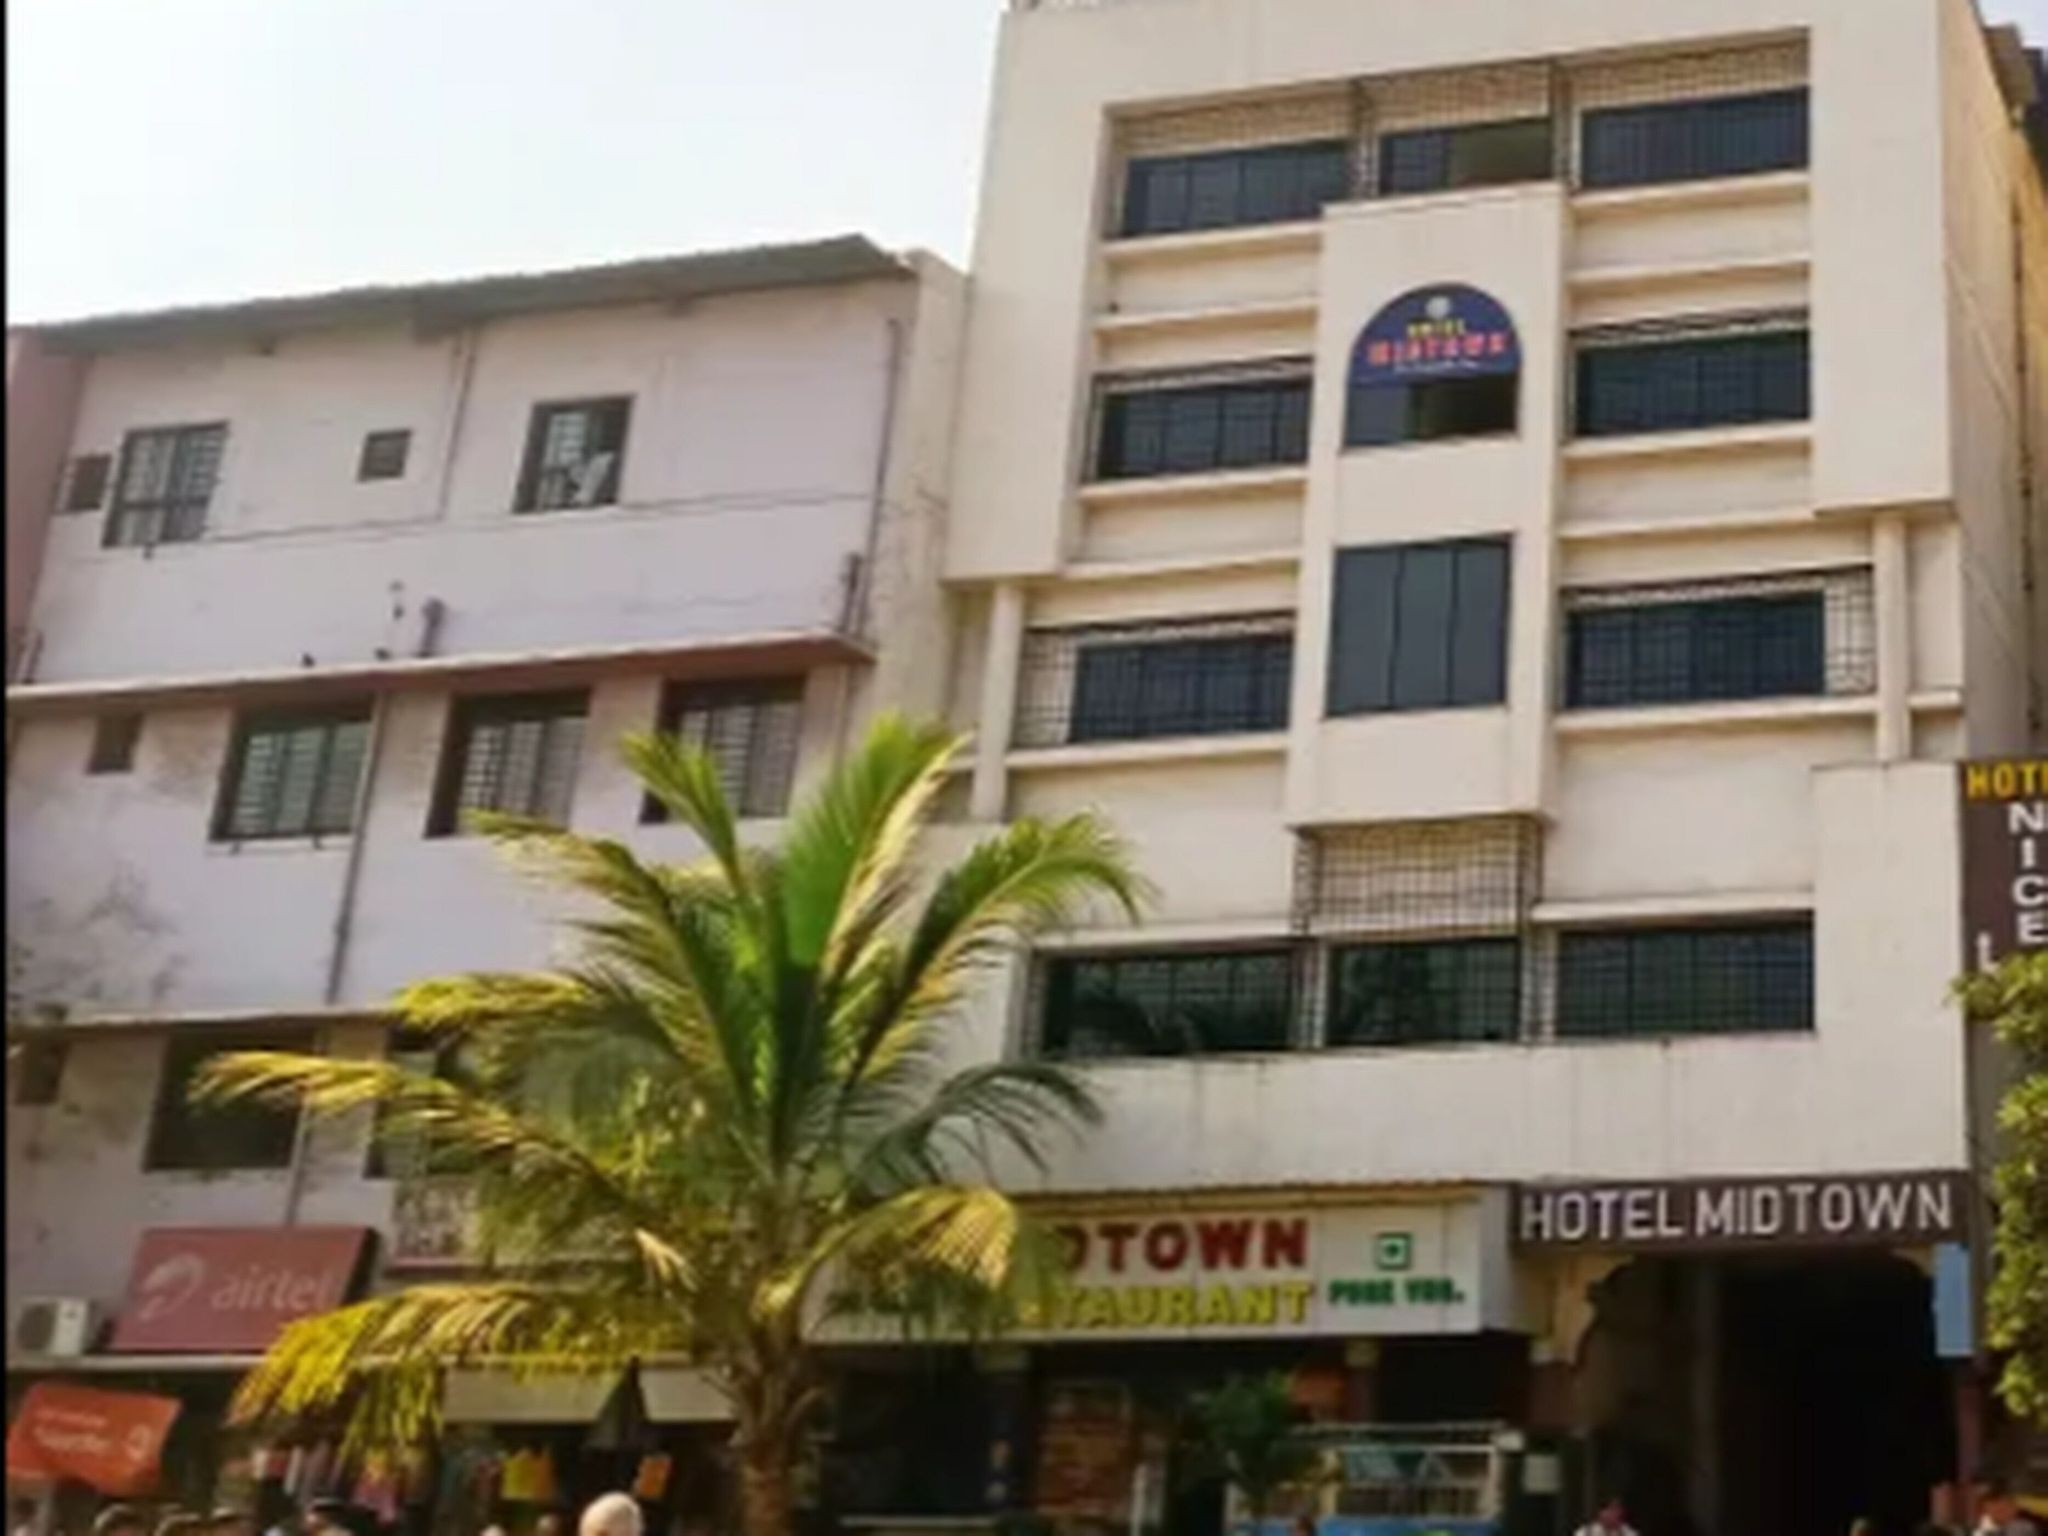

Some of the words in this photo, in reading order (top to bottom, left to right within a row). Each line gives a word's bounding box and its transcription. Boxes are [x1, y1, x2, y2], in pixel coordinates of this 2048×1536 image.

[2008, 800, 2048, 945] NICE
[1520, 1188, 1685, 1241] HOTEL
[1696, 1182, 1952, 1237] MIDTOWN
[1053, 1218, 1309, 1275] DTOWN
[210, 1263, 335, 1312] airtel
